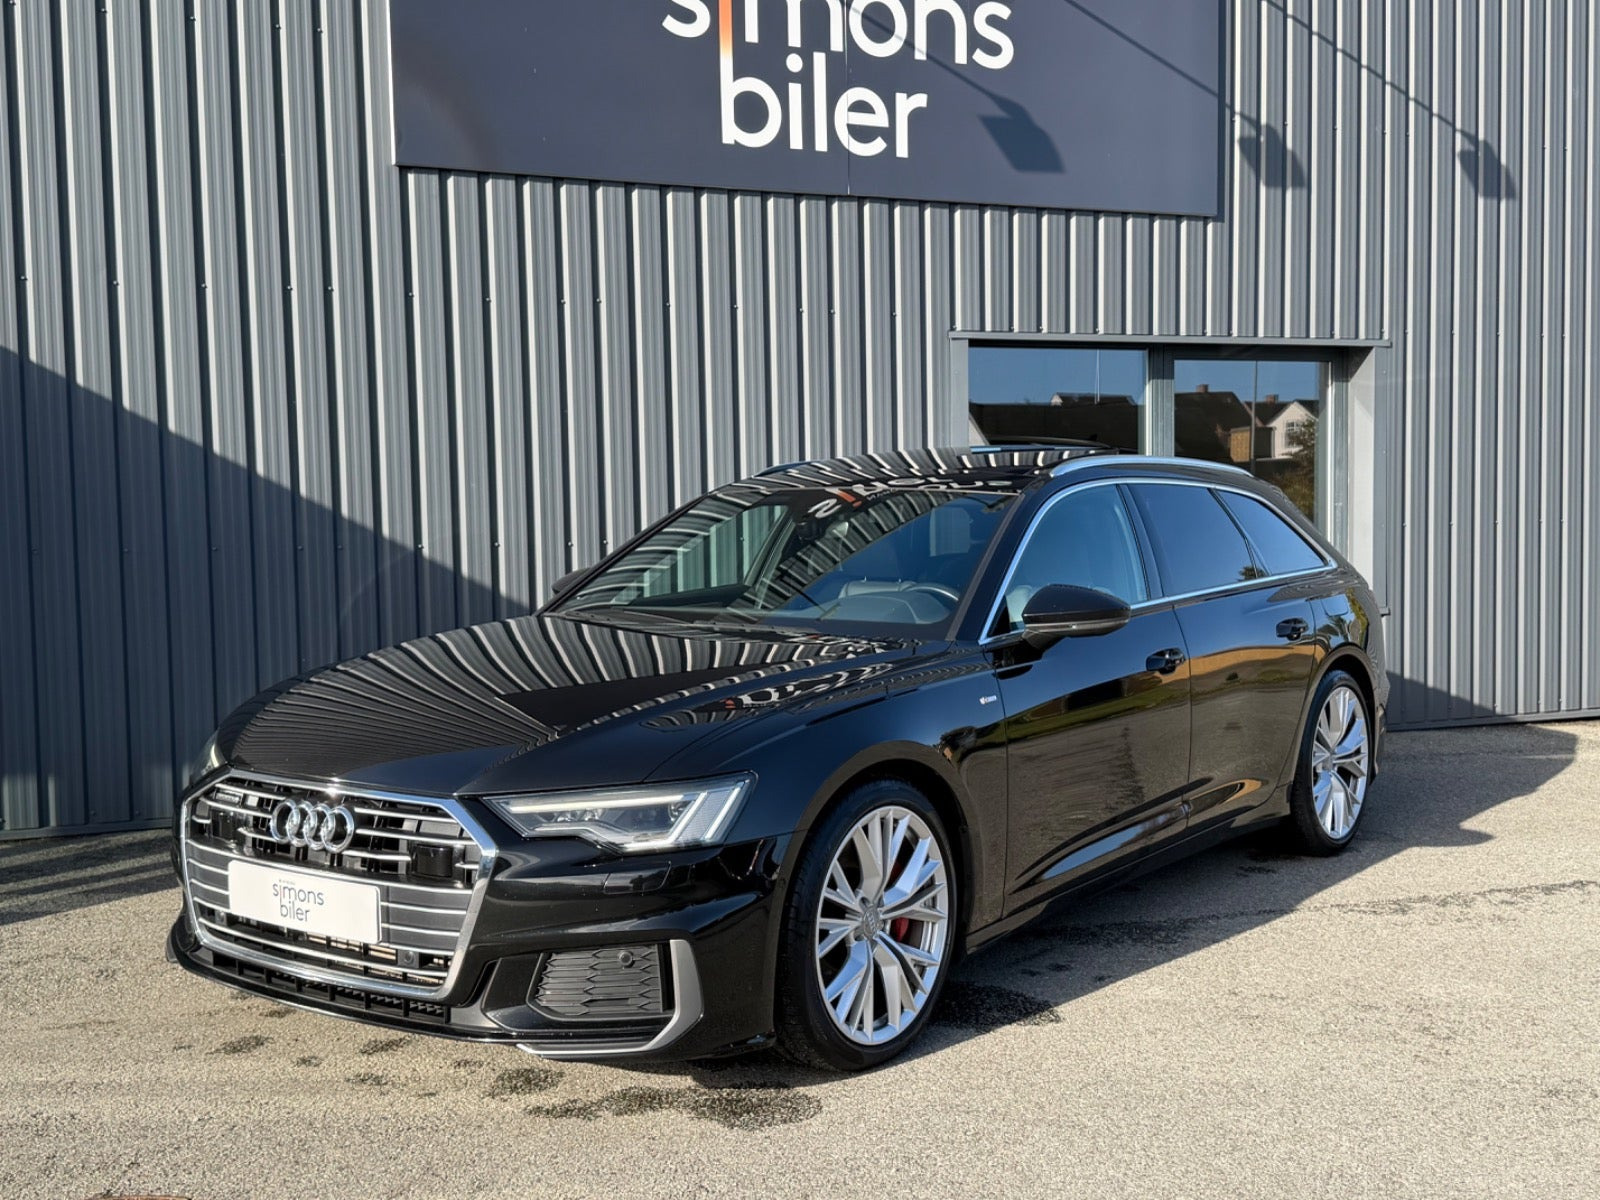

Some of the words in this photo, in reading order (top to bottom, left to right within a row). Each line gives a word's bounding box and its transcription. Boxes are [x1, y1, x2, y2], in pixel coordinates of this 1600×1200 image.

[719, 51, 928, 159] biler
[272, 883, 325, 906] simons
[279, 900, 310, 922] biler
